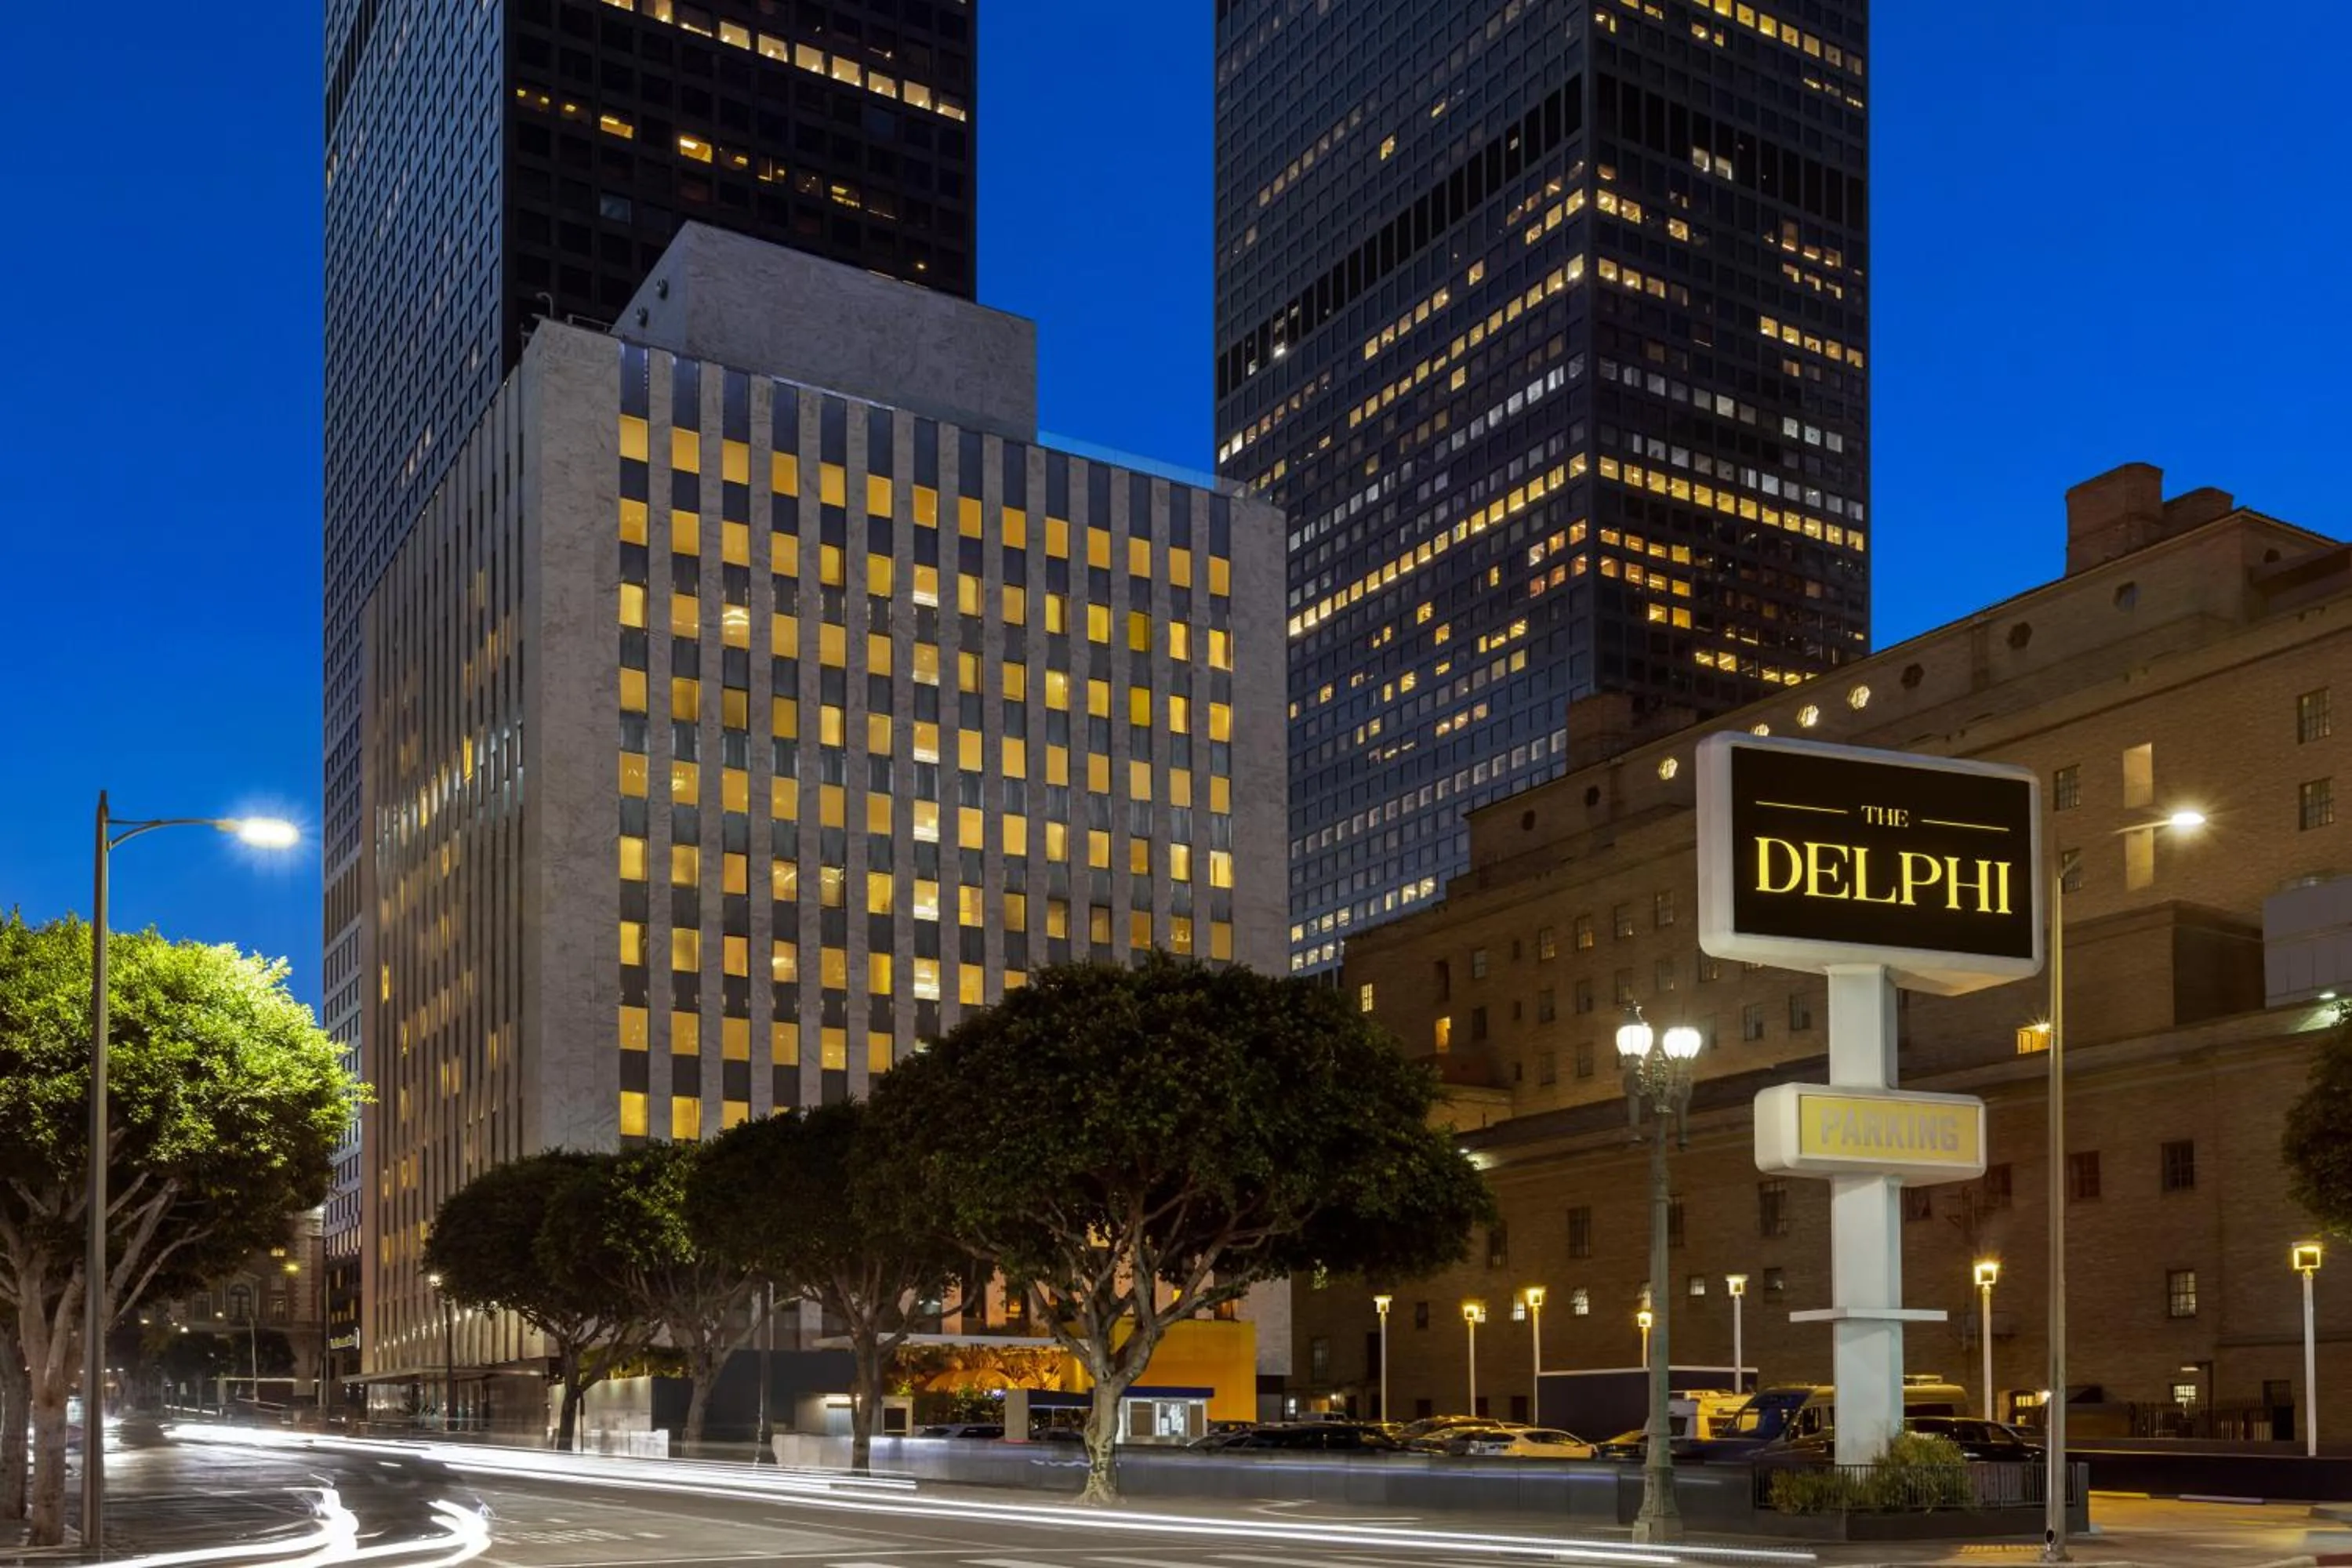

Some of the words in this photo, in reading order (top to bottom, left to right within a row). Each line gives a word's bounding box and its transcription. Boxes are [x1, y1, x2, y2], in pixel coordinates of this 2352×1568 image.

[1860, 805, 1909, 828] THE
[1755, 837, 2012, 914] DELPHI
[1820, 1105, 1958, 1152] PARKING
